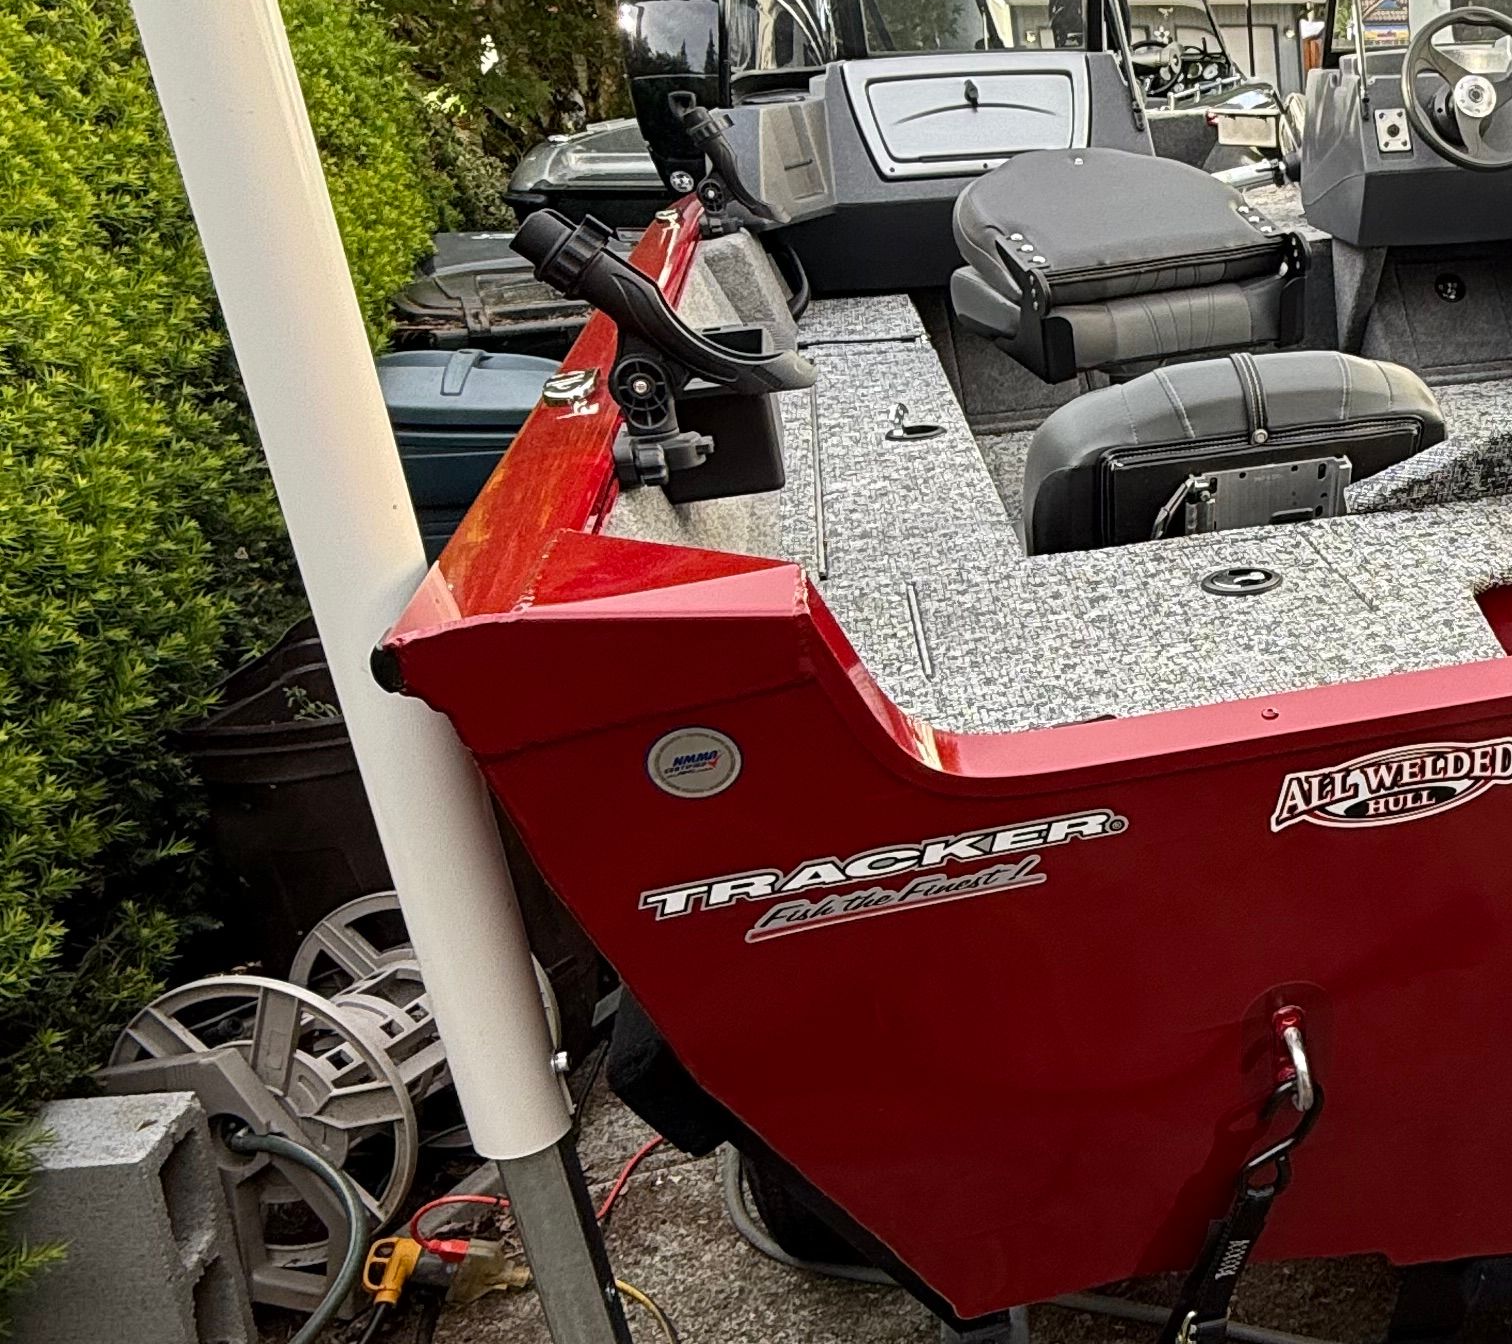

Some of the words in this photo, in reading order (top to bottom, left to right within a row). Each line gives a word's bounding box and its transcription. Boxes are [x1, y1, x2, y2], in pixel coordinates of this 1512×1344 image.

[1279, 771, 1361, 821] ALL
[1366, 790, 1436, 816] HULL
[645, 813, 1113, 917] TRACKER
[759, 898, 834, 928] Fish
[843, 891, 893, 911] the
